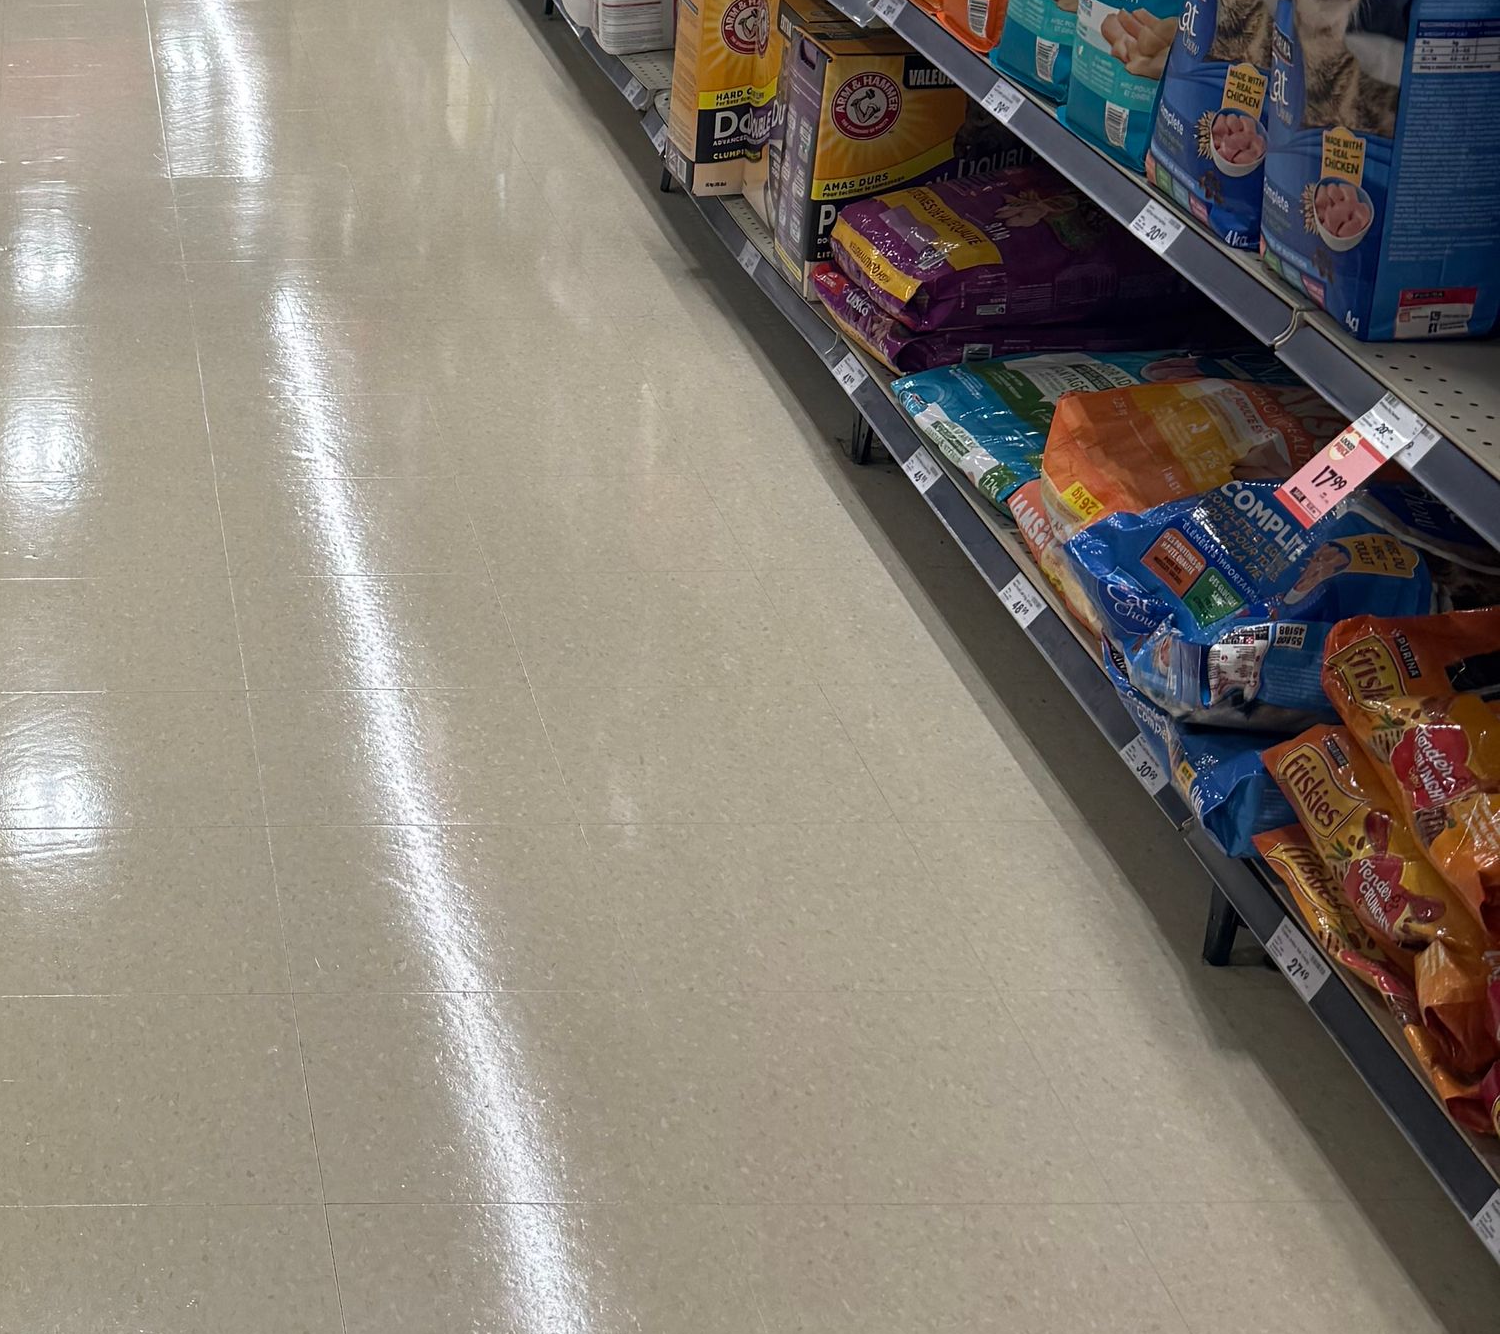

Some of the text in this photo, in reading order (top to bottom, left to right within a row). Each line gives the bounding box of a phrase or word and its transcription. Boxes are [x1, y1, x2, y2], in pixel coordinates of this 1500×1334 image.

[1229, 68, 1265, 88] MADE WITH
[715, 88, 746, 101] HARD
[836, 81, 854, 114] ARM
[862, 74, 899, 113] HAMMER
[1237, 83, 1253, 95] REAL
[1226, 89, 1260, 110] CHICKEN
[1324, 134, 1363, 152] MADE WITH
[1332, 149, 1349, 161] REAL
[1324, 159, 1360, 177] CHICKEN
[823, 172, 889, 192] AMAS DURS
[1398, 634, 1420, 679] PURINA
[1282, 753, 1343, 829] Friskies
[1359, 858, 1393, 902] Tender
[1358, 881, 1390, 931] CRUNCHY
[1285, 957, 1310, 981] 2749
